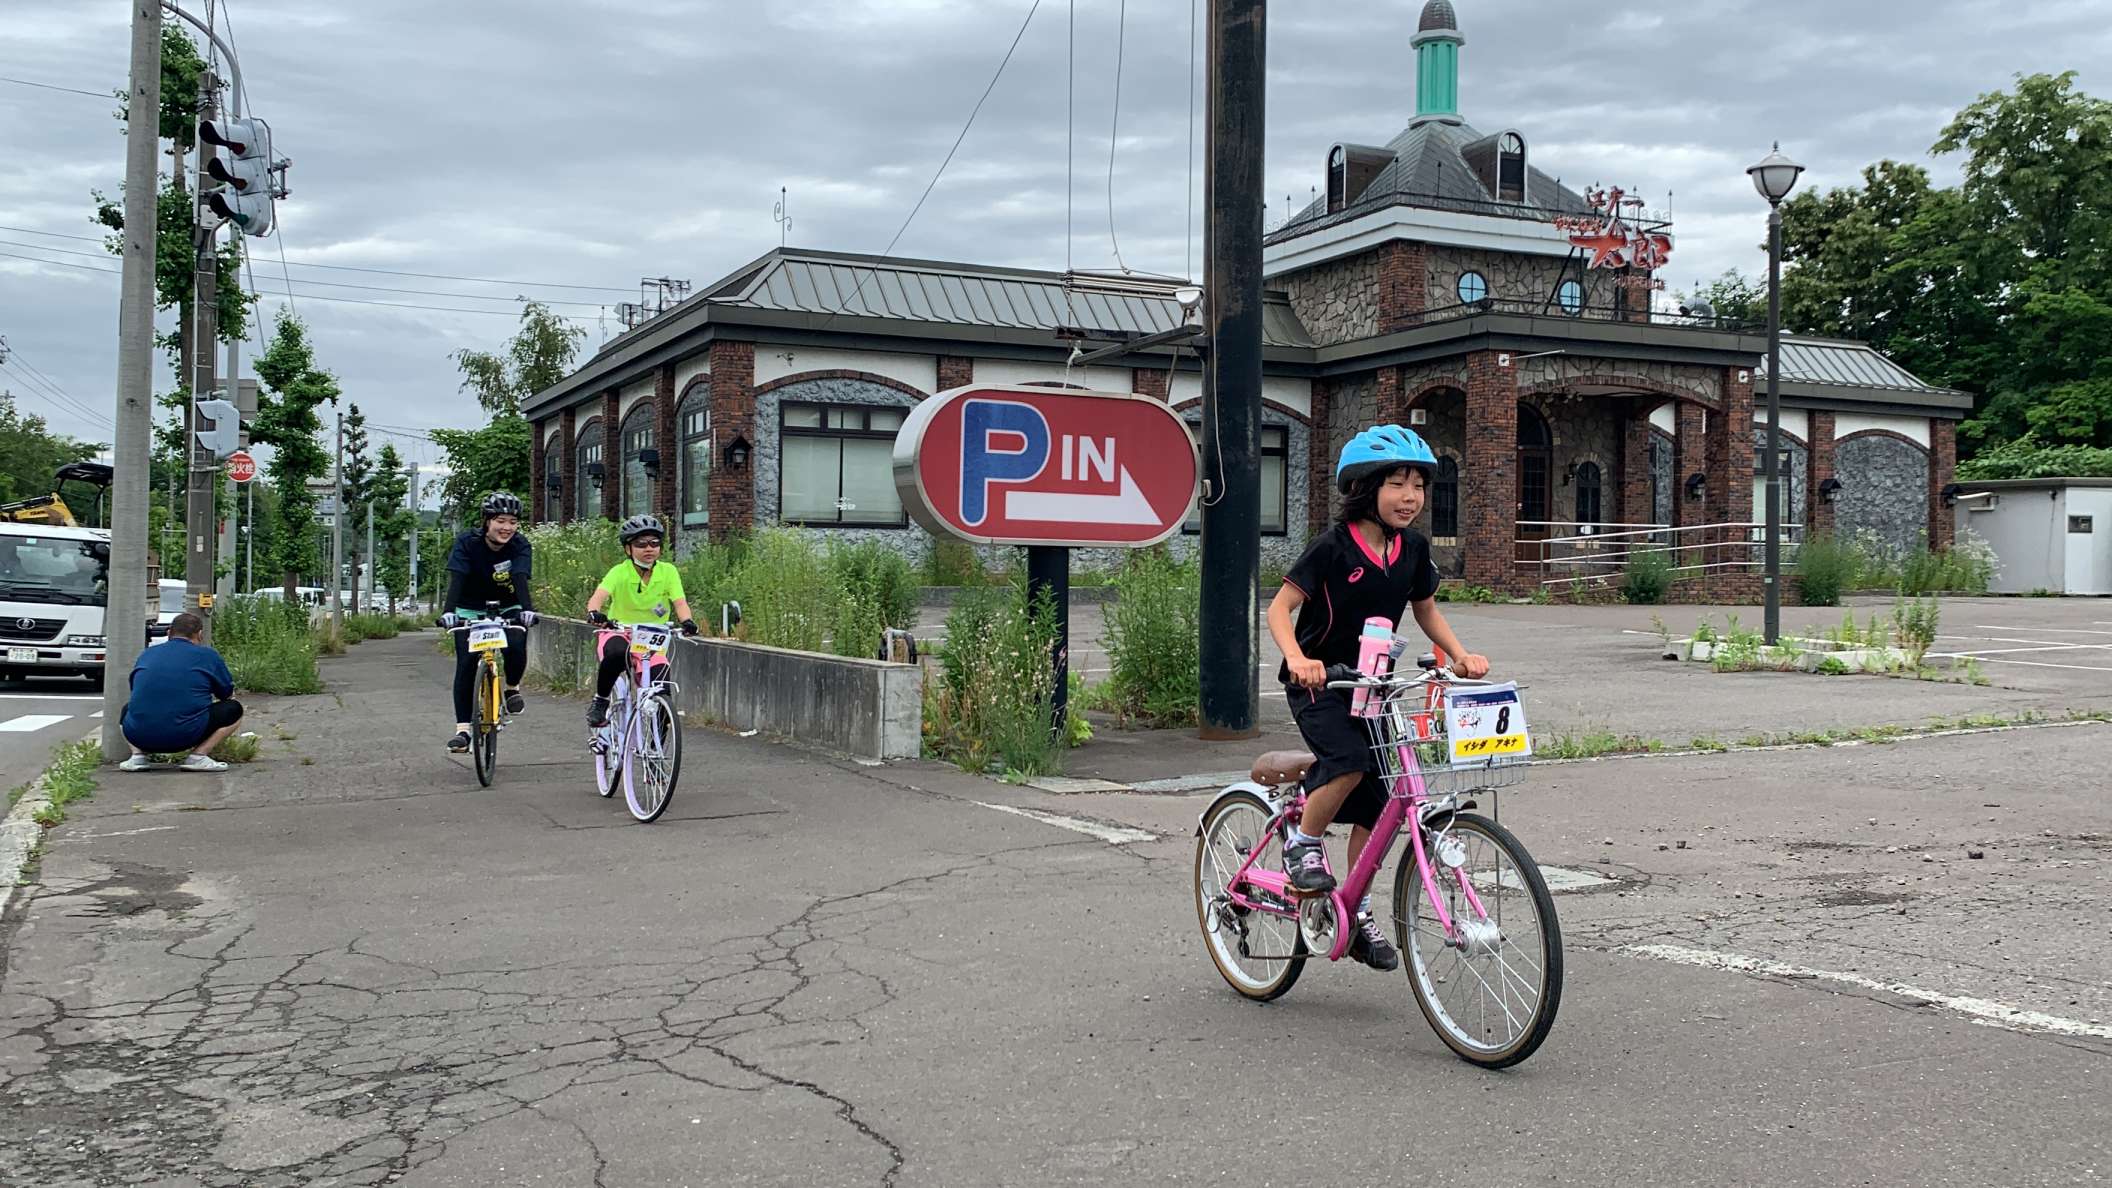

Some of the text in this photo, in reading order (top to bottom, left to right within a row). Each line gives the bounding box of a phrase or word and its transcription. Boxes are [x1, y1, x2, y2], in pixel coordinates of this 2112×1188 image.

[959, 399, 1115, 527] P IN
[649, 634, 666, 646] 59
[1495, 705, 1510, 735] 8
[1464, 739, 1488, 752] イシダ
